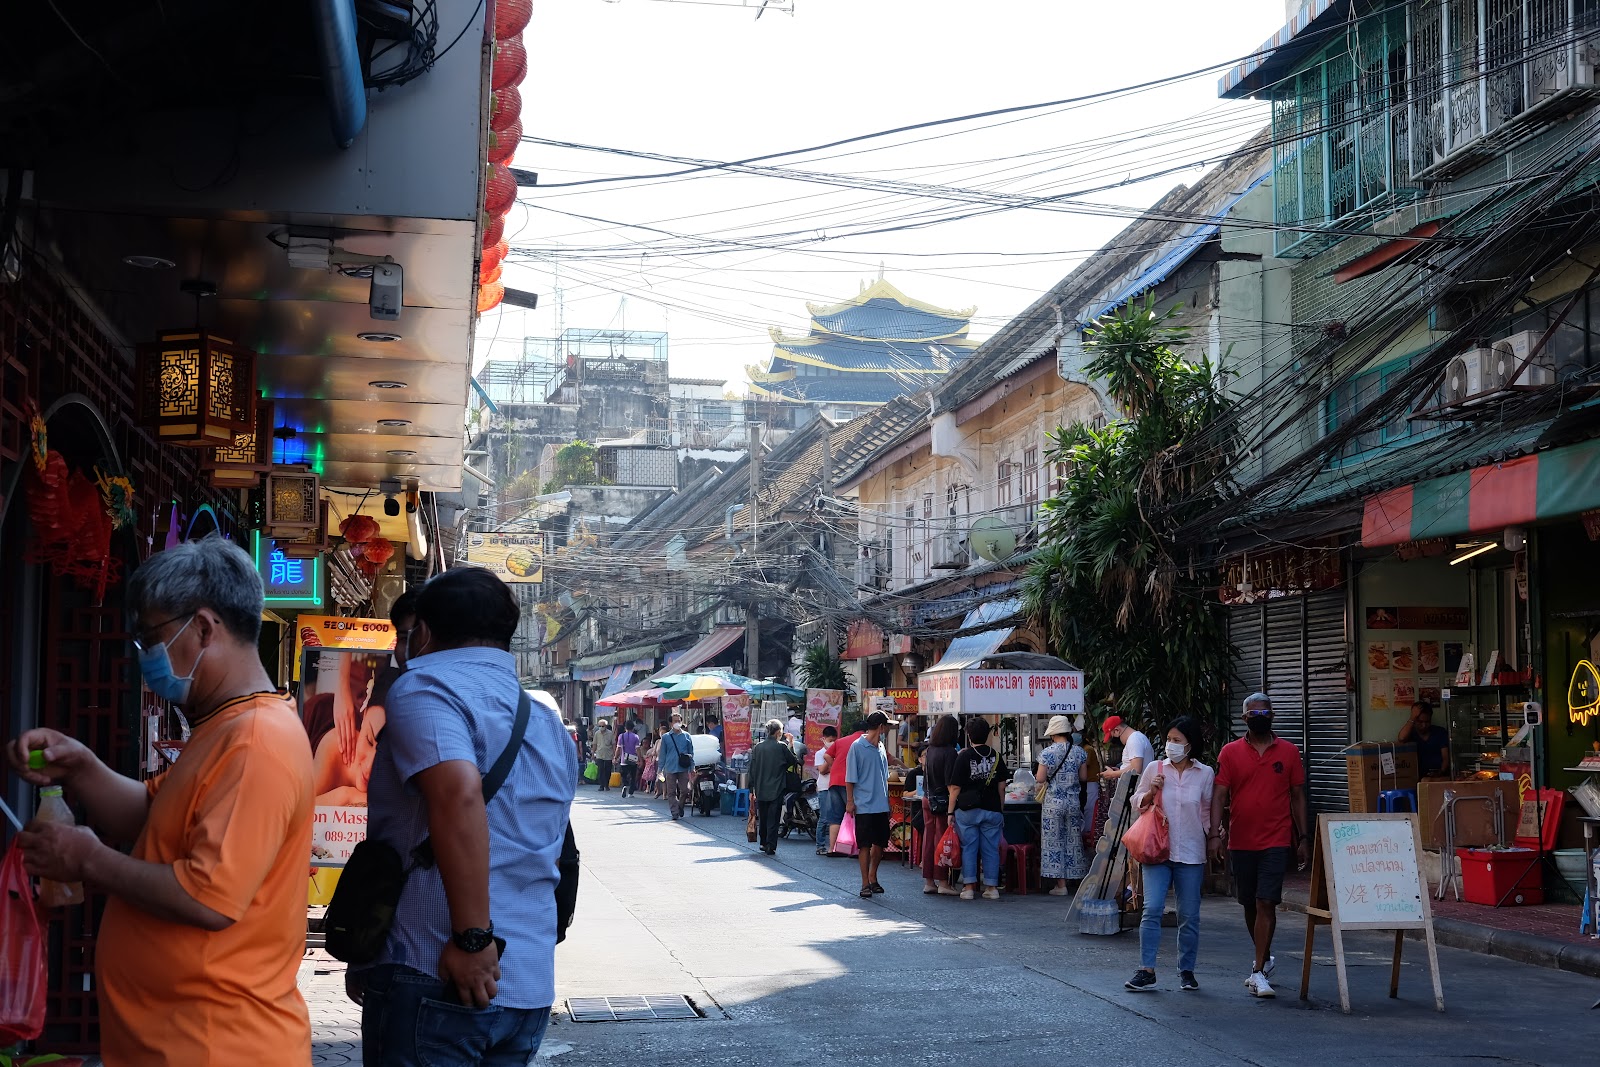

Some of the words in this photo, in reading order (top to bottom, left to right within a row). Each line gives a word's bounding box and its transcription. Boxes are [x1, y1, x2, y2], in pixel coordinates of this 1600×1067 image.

[323, 620, 358, 631] SEOUL
[362, 623, 389, 633] GOOD
[968, 673, 1023, 690] กระเพาะปลา
[1028, 674, 1078, 697] สูตรหูฉลาม
[889, 690, 913, 699] KUAY
[1333, 823, 1361, 839] อร่อย
